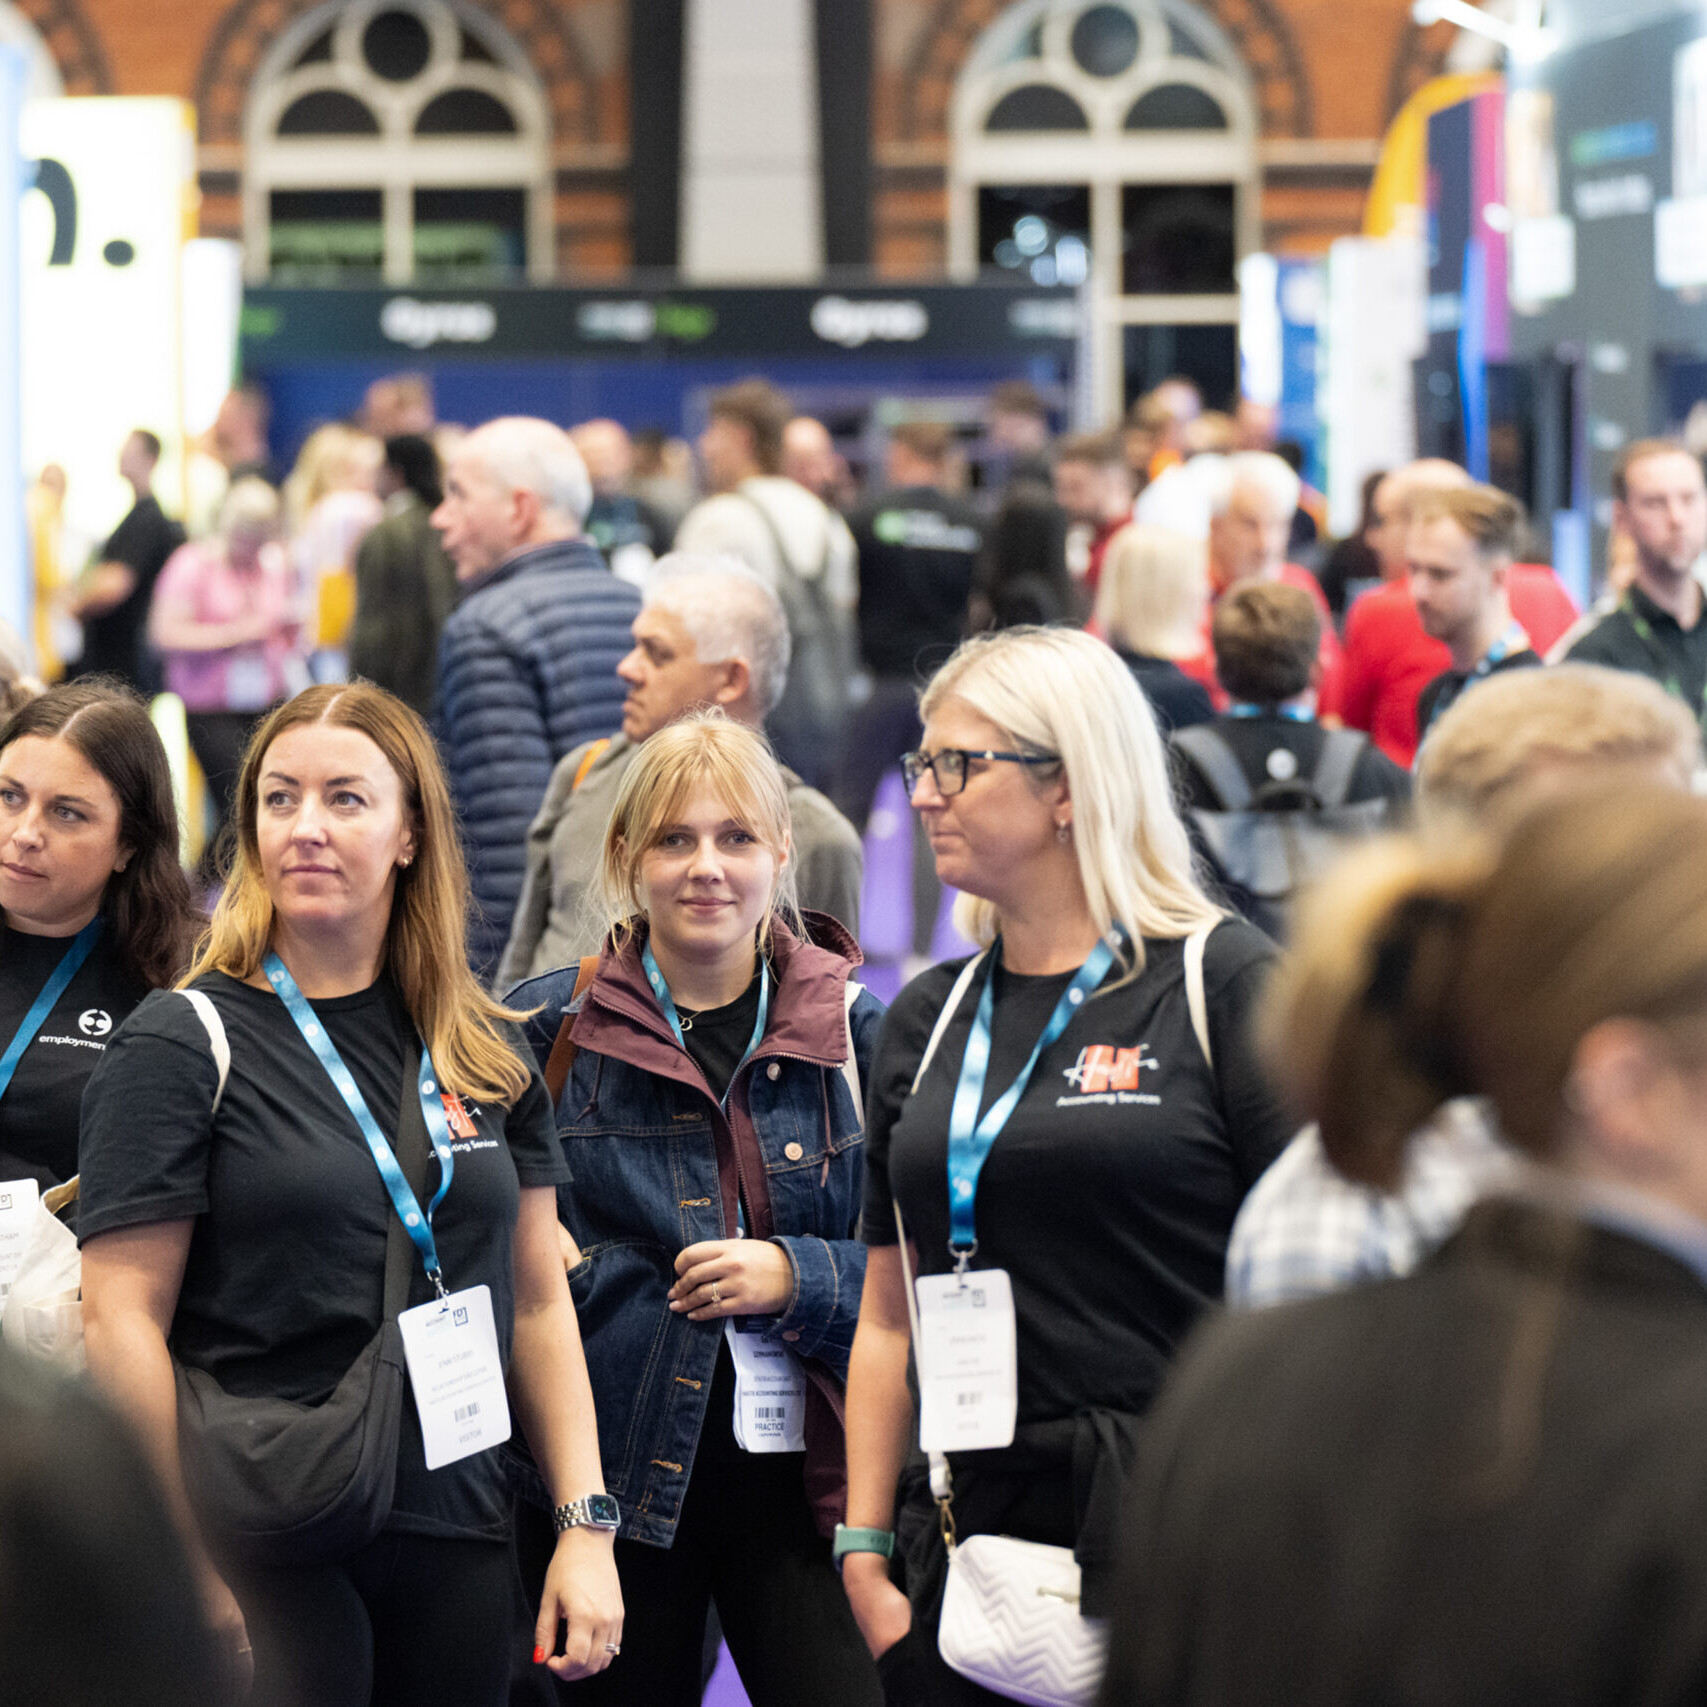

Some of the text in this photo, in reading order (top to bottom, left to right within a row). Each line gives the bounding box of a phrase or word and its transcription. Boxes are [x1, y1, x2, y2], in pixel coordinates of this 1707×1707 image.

[1056, 1091, 1162, 1108] Accounting Services
[755, 1422, 785, 1431] PRACTICE
